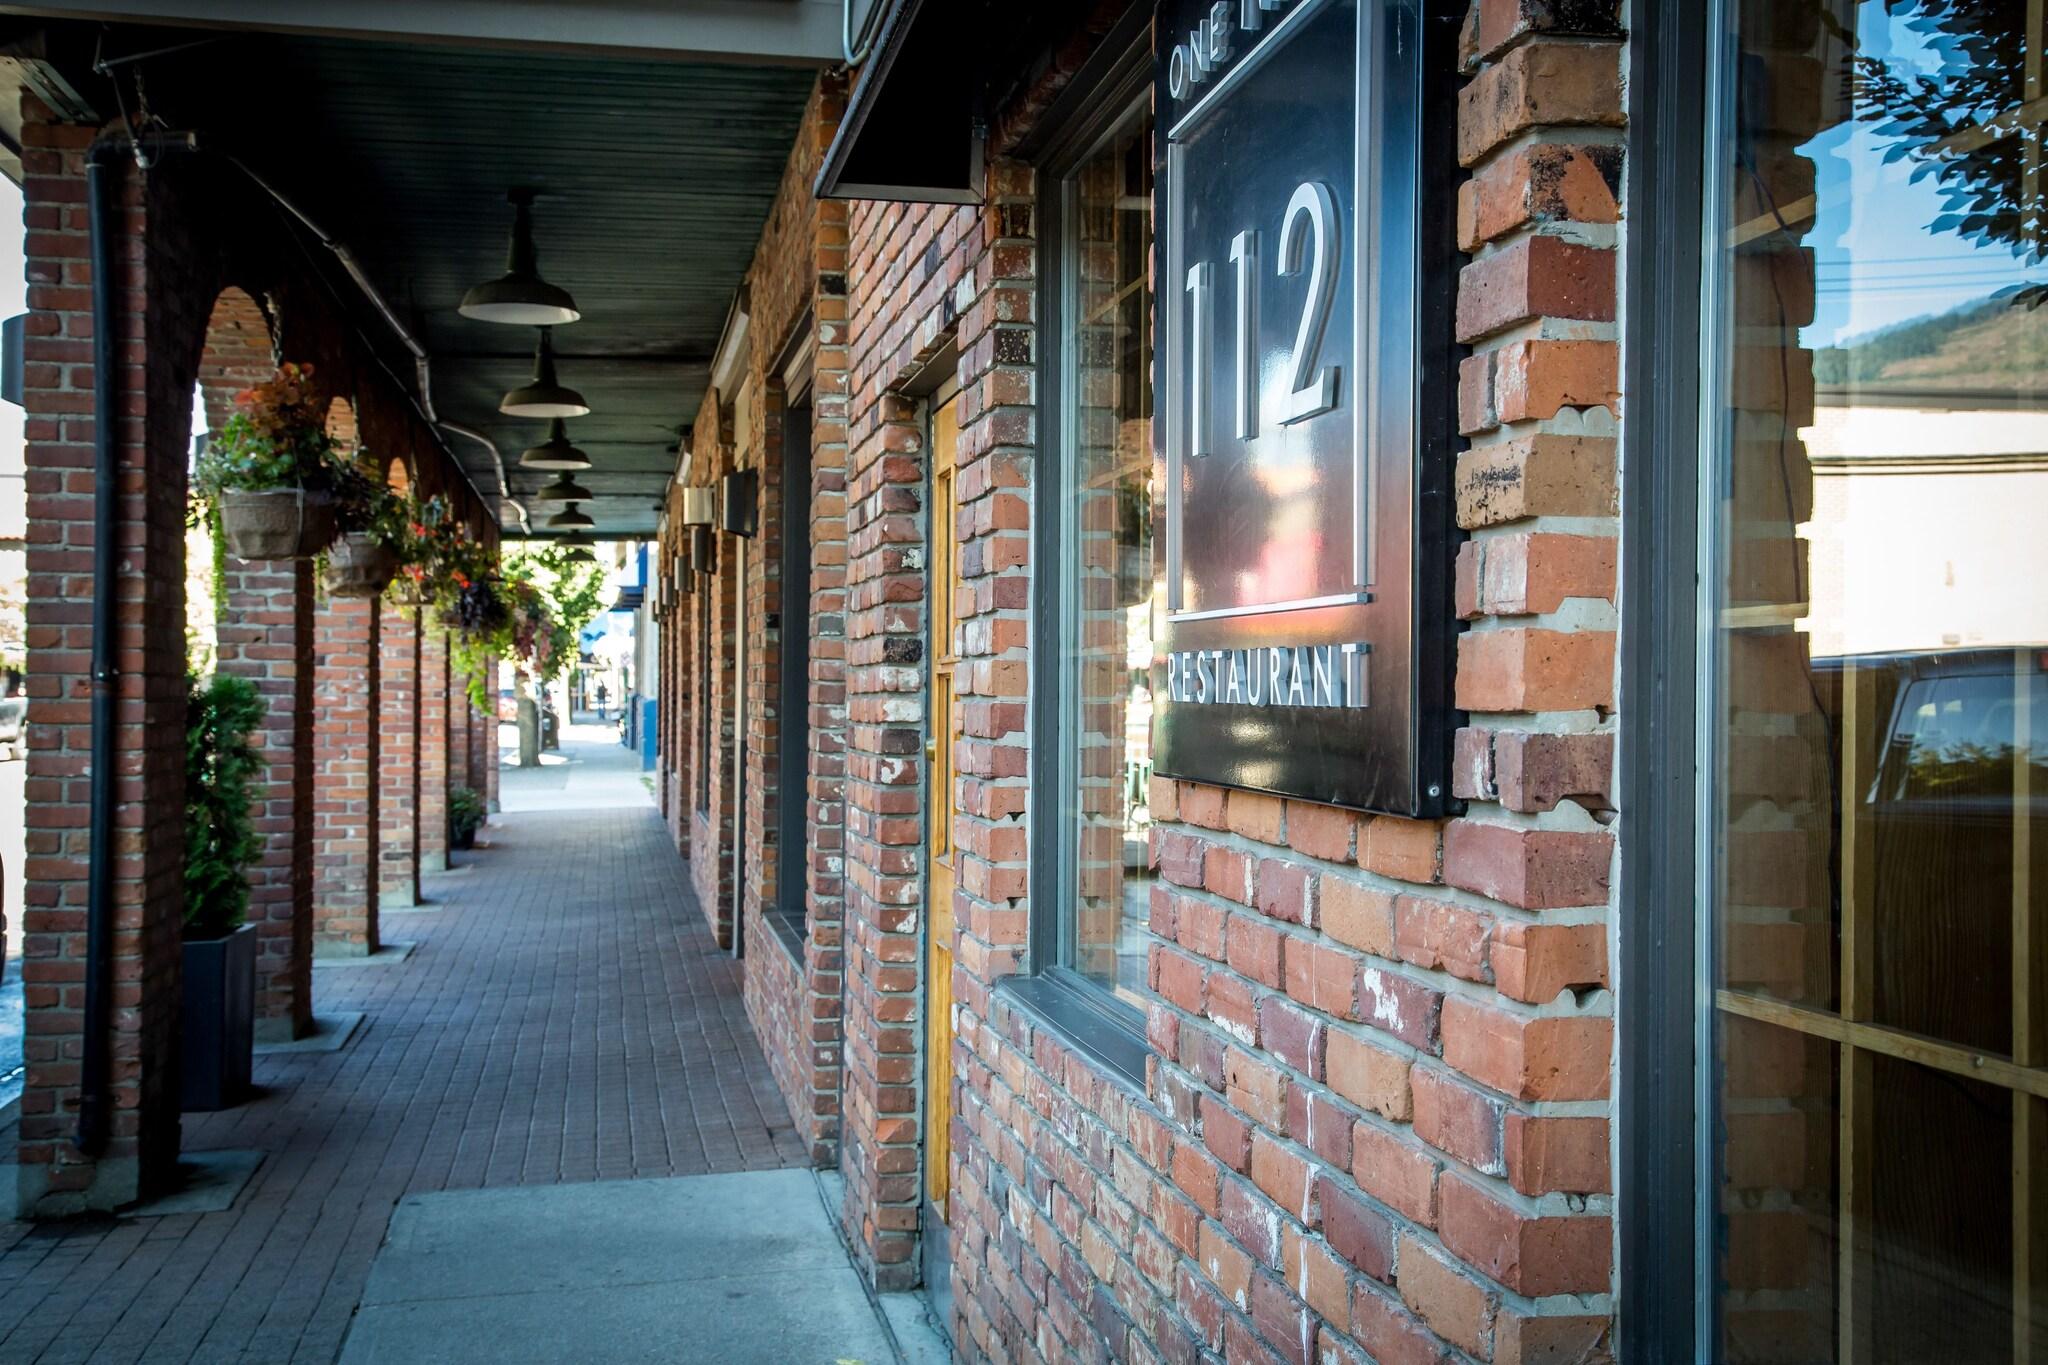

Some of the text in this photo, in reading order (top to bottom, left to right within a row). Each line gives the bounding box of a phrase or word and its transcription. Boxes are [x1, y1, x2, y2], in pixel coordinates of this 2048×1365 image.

[1169, 1, 1226, 99] ONE
[1186, 181, 1336, 457] 112
[1167, 643, 1368, 707] RESTAURANT
